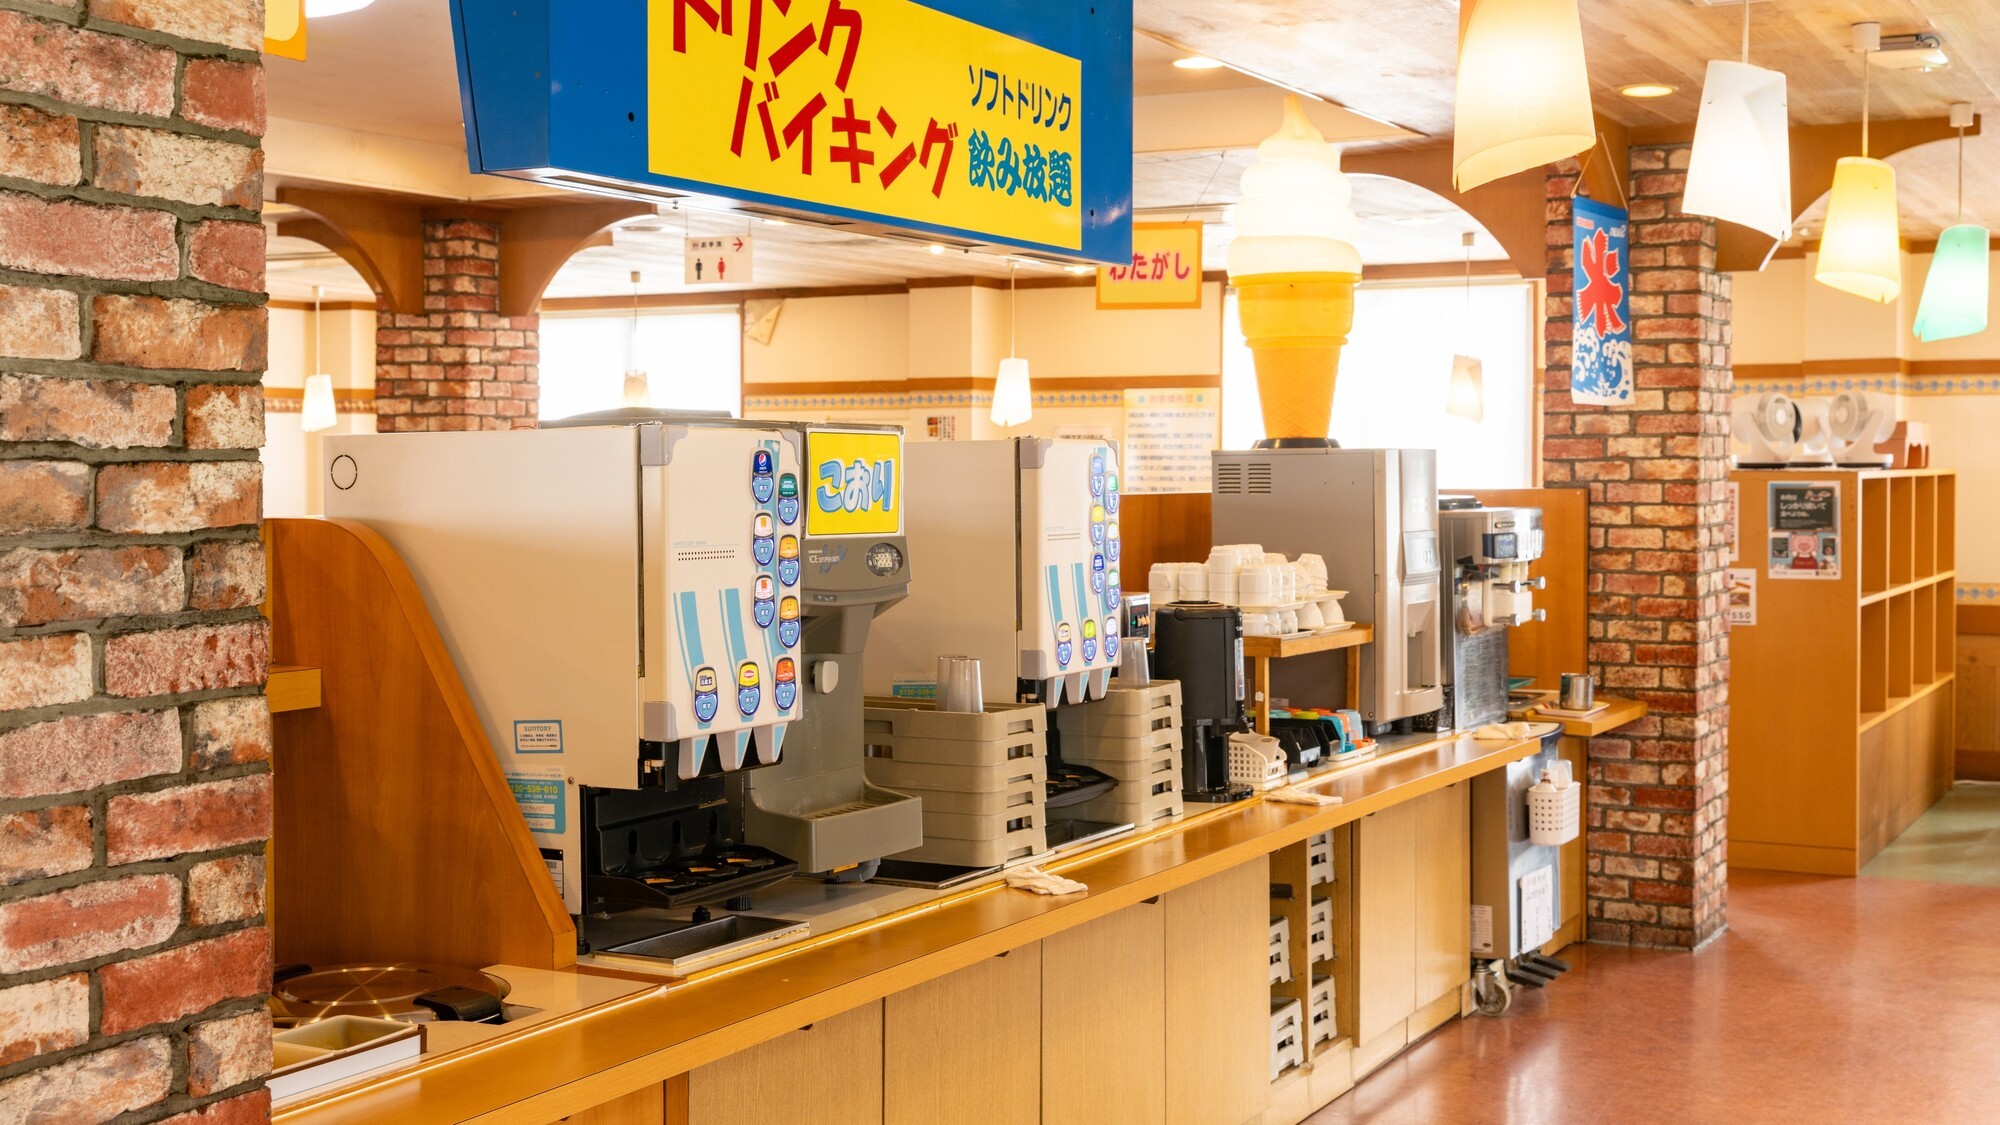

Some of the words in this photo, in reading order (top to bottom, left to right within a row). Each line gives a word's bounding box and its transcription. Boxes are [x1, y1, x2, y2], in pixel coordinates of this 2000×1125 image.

[968, 64, 1072, 132] ソフトドリンク
[730, 75, 959, 199] バイキング
[968, 128, 1072, 208] 飲み放題
[816, 459, 893, 513] こおり
[511, 784, 558, 794] 120-539-610
